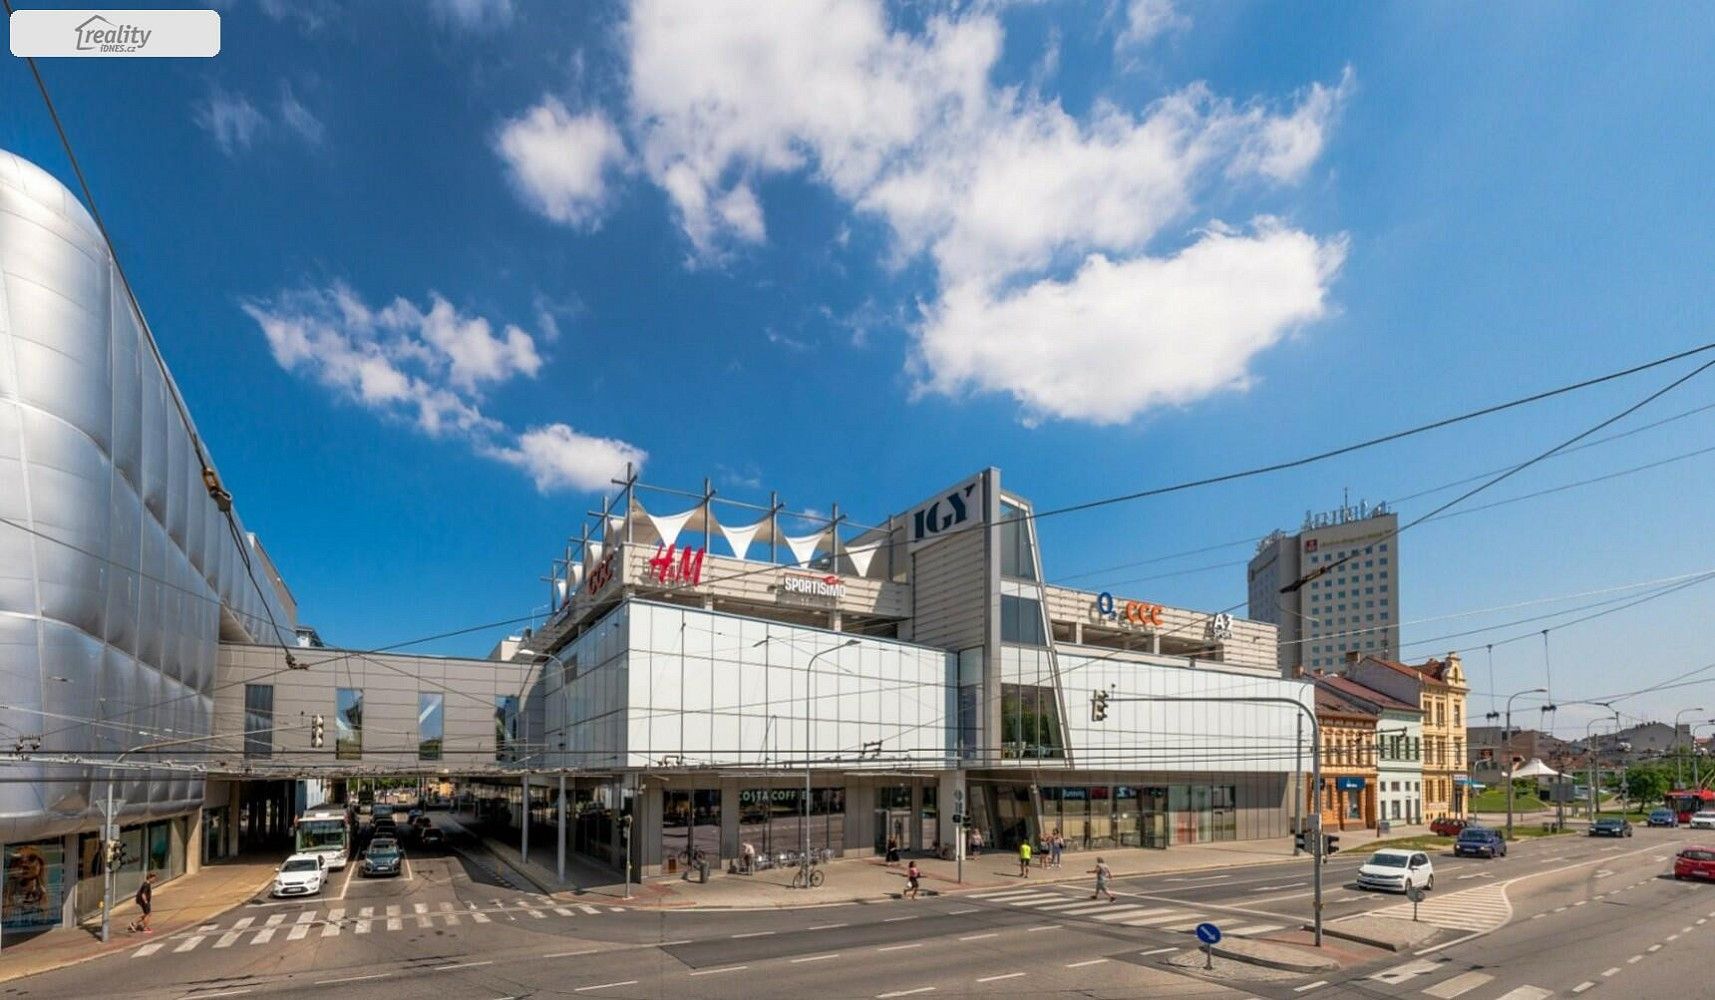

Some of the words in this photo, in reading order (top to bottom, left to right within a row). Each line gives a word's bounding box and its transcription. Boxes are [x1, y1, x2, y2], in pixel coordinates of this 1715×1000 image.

[914, 482, 976, 539] IGY
[784, 576, 846, 598] SPORTISIMO
[1126, 600, 1164, 626] CCC
[739, 790, 769, 801] OSTA
[770, 790, 808, 801] COFFE
